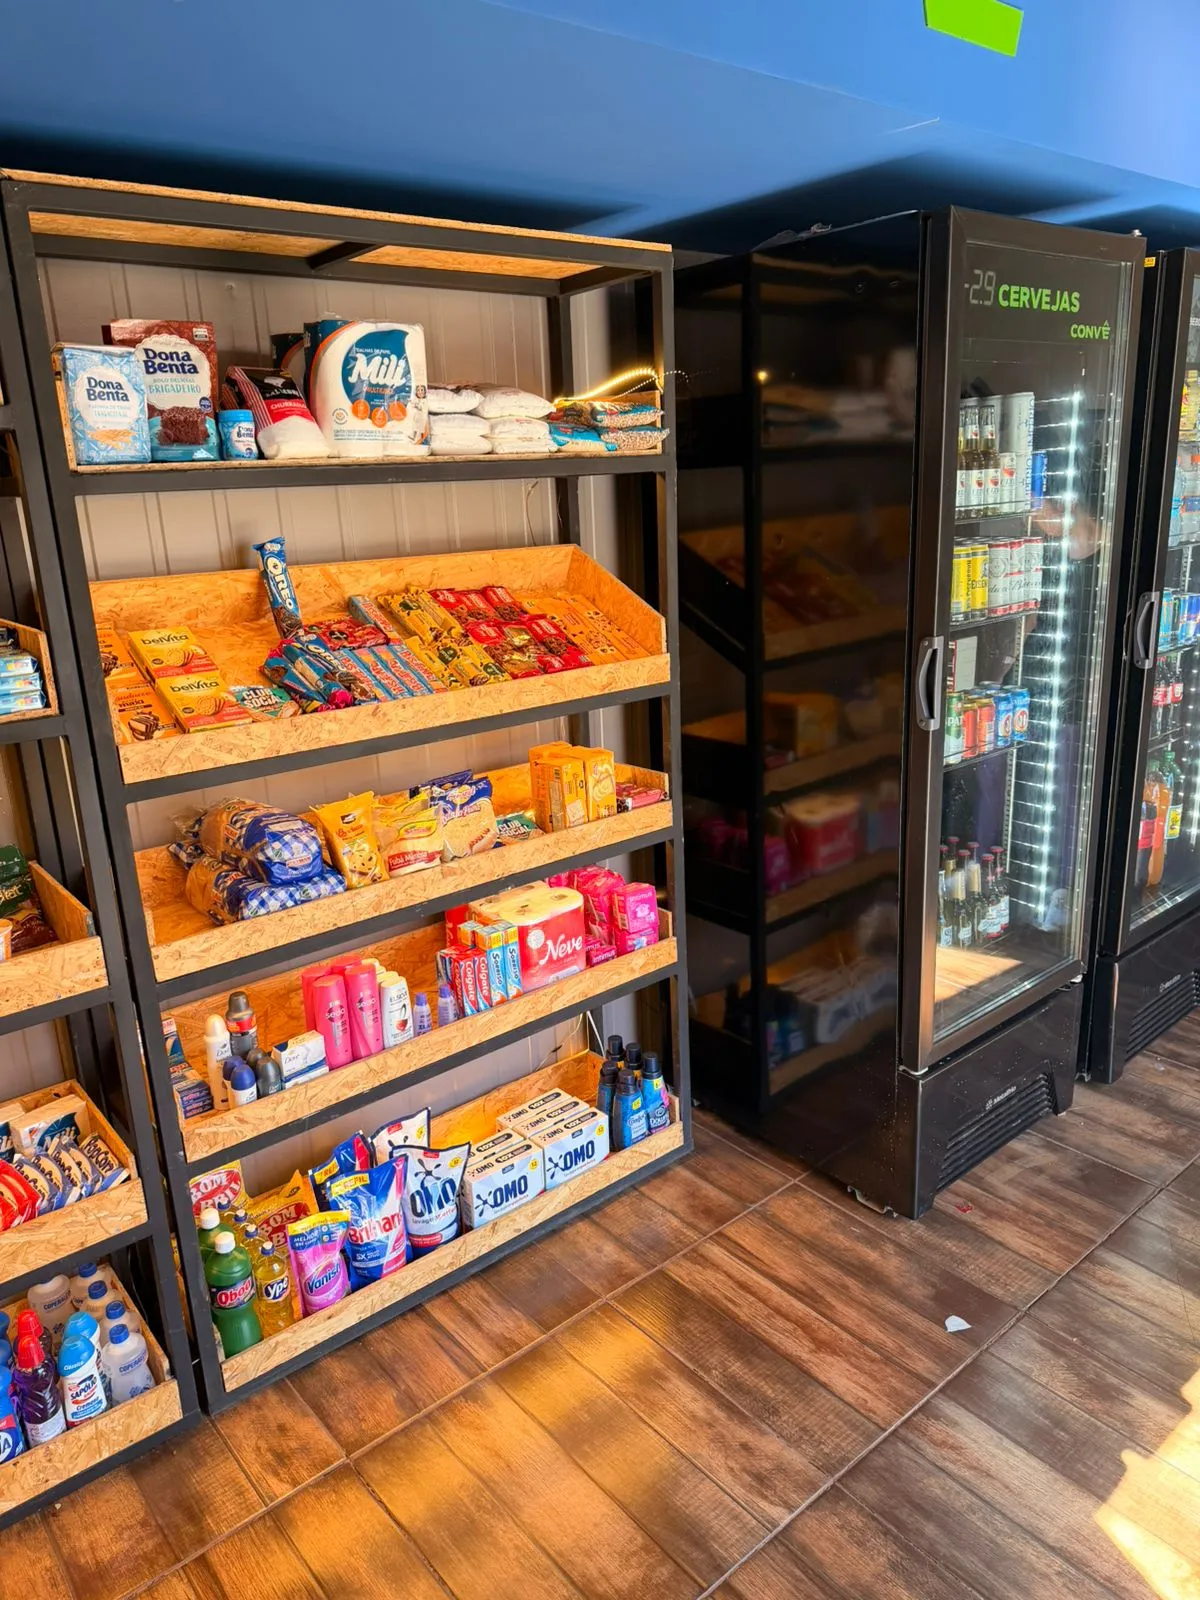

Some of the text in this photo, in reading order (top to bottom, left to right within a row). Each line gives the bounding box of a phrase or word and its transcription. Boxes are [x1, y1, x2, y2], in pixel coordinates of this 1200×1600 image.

[998, 284, 1081, 313] CERVEJAS
[1070, 320, 1110, 340] CONVÊ
[143, 348, 192, 361] Dona
[143, 360, 199, 374] Benta
[87, 377, 124, 390] Dona
[86, 388, 130, 402] Benta
[266, 556, 294, 610] OREO
[141, 633, 190, 645] belVita
[170, 680, 220, 692] belVita
[242, 689, 274, 701] CLUB
[539, 934, 583, 965] Neve
[465, 960, 475, 1001] Colgate
[479, 957, 489, 996] Colgate
[511, 1099, 545, 1119] OMO 10X
[529, 1108, 564, 1128] OMO 10X
[546, 1118, 582, 1138] OMO 10X
[477, 1141, 493, 1152] 10X
[564, 1140, 595, 1171] OMO
[475, 1152, 512, 1174] OMO 10X
[190, 1173, 227, 1203] BOM
[410, 1177, 457, 1218] OMO
[493, 1175, 528, 1208] OMO
[259, 1205, 297, 1236] BOM
